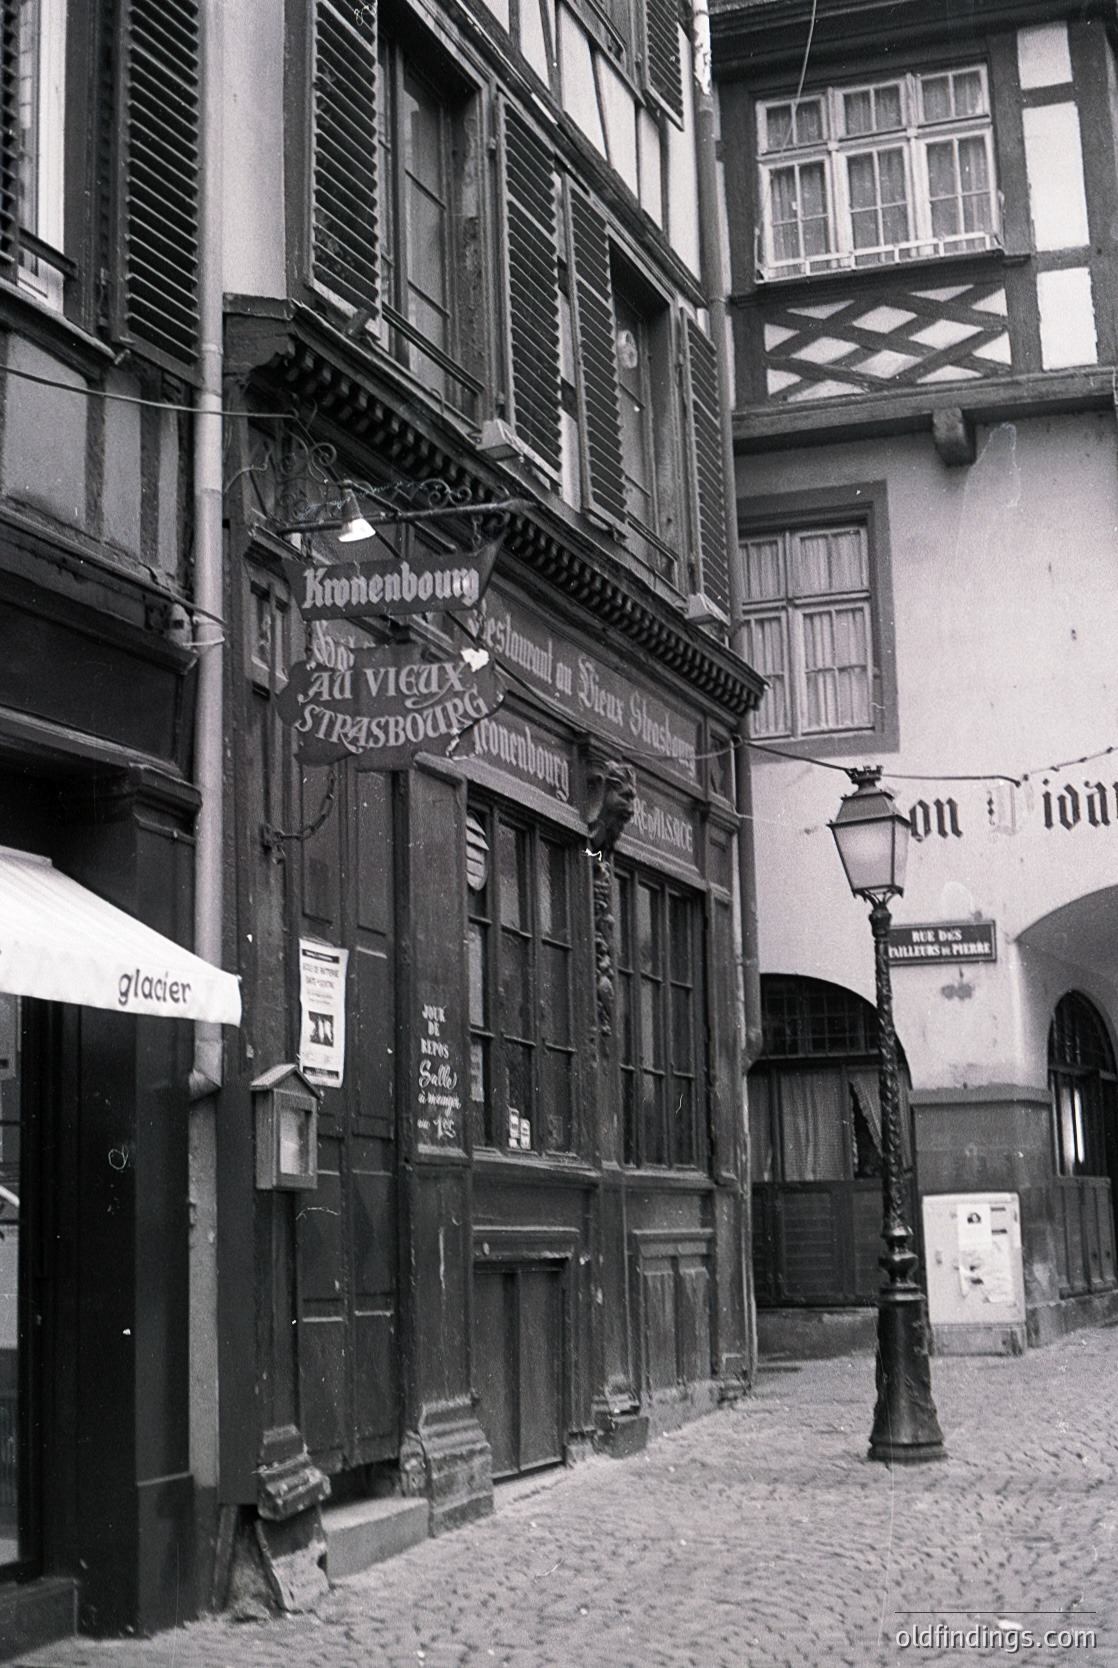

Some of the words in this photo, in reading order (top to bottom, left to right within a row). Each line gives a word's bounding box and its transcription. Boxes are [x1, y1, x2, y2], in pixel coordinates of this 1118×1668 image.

[302, 561, 480, 607] Kronenbourg
[298, 670, 354, 703] AU
[363, 662, 466, 709] VIEUX
[577, 656, 624, 728] Vieux
[295, 687, 489, 754] STRASBOURG
[912, 930, 935, 943] RUE
[938, 928, 963, 942] DES
[952, 941, 991, 956] PIERRE
[119, 969, 192, 1006] glacier
[422, 1004, 447, 1023] JOUR
[428, 1020, 440, 1037] DE
[421, 1038, 449, 1059] REPOS
[419, 1059, 457, 1090] Salle
